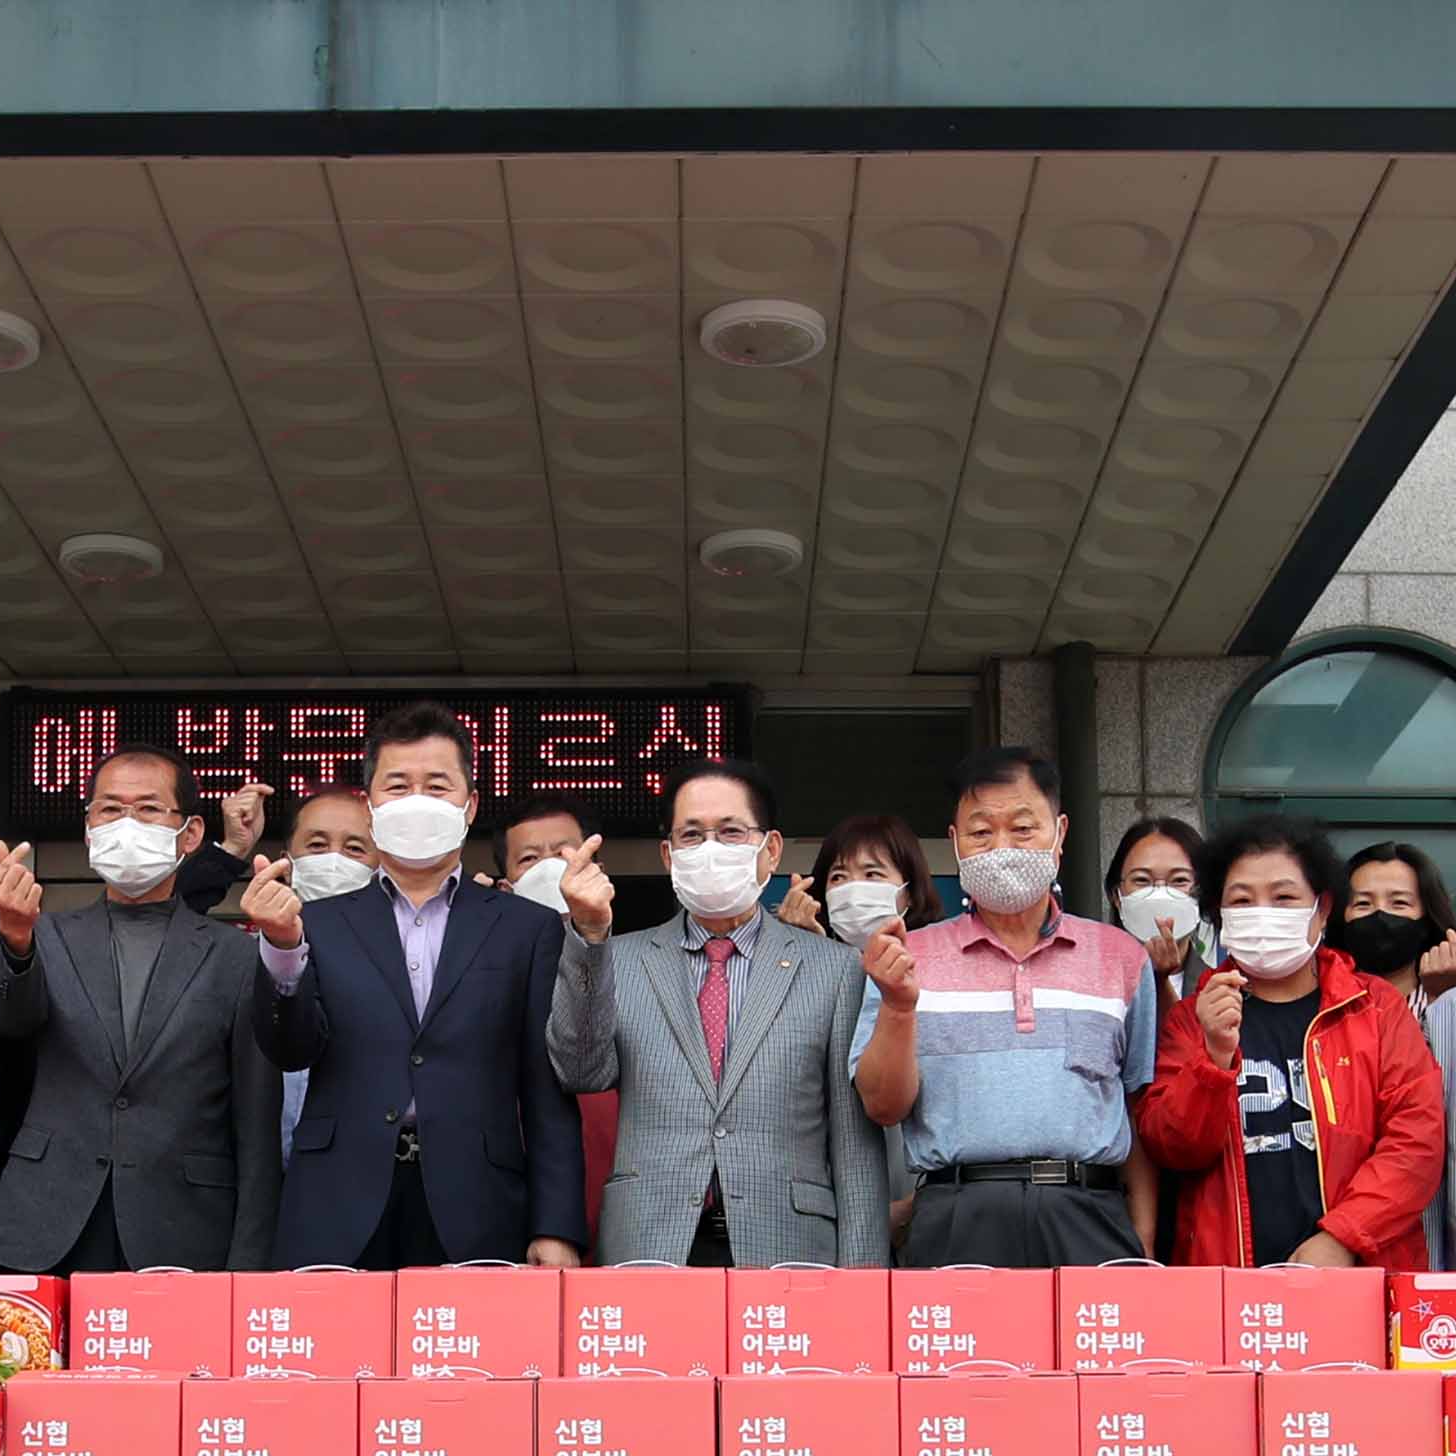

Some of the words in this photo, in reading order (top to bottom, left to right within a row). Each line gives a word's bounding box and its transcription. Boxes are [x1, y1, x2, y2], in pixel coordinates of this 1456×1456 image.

[85, 1308, 128, 1332] 신협
[247, 1307, 290, 1332] 신협
[578, 1305, 622, 1330] 신협
[1075, 1302, 1120, 1327] 신협
[84, 1336, 152, 1360] 어부바
[246, 1335, 315, 1359] 어부바
[578, 1334, 647, 1358] 어부바
[1076, 1331, 1145, 1355] 어부바
[22, 1420, 68, 1447] 신협
[197, 1417, 245, 1444] 신협
[375, 1418, 422, 1445] 신협
[555, 1418, 602, 1445] 신협
[738, 1416, 786, 1444] 신협
[918, 1416, 965, 1443] 신협
[1096, 1413, 1144, 1440] 신협
[1281, 1411, 1330, 1438] 신협
